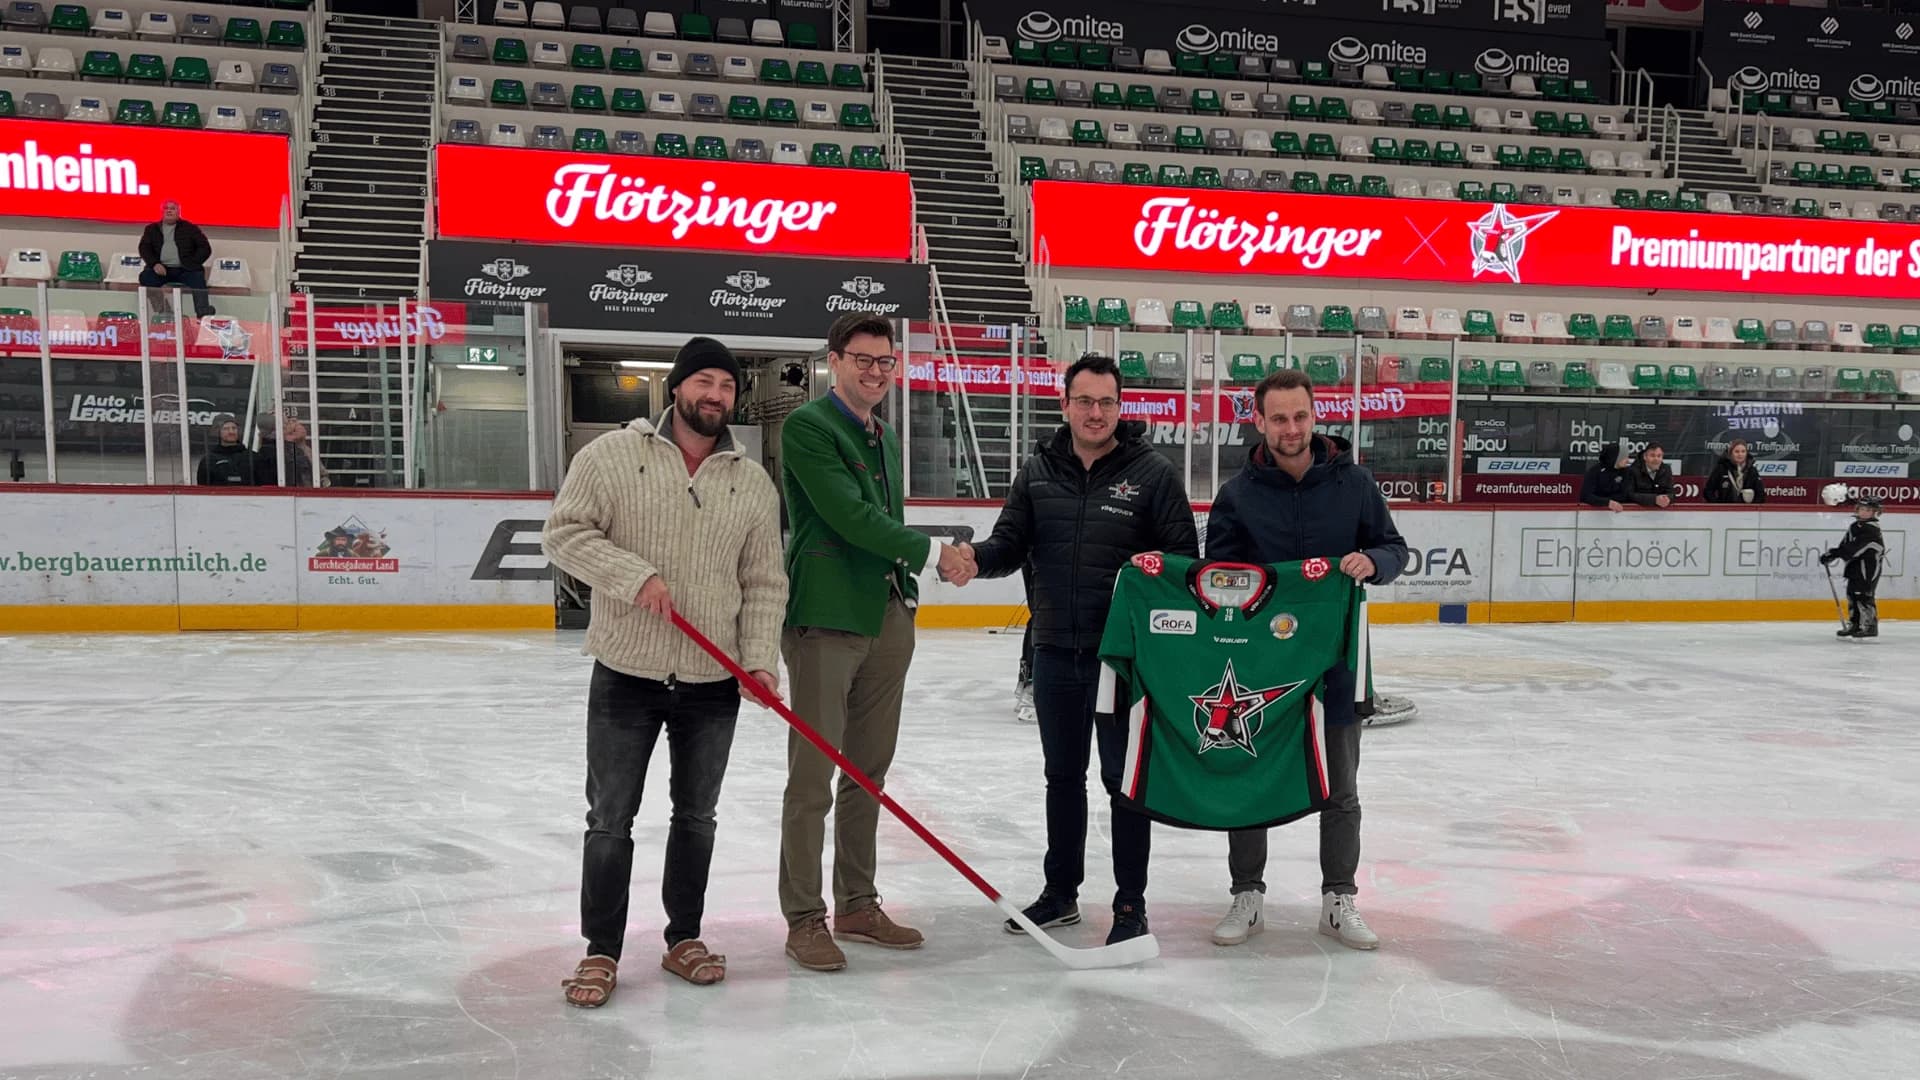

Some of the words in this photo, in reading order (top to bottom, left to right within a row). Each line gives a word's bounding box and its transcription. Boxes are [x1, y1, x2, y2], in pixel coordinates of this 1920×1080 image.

[1063, 15, 1124, 40] mitea
[1219, 28, 1279, 52] mitea
[1370, 40, 1427, 63] mitea
[1515, 51, 1570, 74] mitea
[1769, 68, 1821, 90] mitea
[1885, 77, 1920, 97] mite
[0, 138, 151, 195] nheim.
[546, 163, 837, 245] Flötzinger
[1134, 196, 1382, 270] Flötzinger
[1611, 225, 1850, 280] Premiumpartner
[1856, 236, 1904, 277] der
[1908, 240, 1920, 278] S
[464, 278, 547, 300] Flötzinger
[589, 283, 668, 306] Flötzinger
[709, 289, 786, 311] Flötzinger
[826, 294, 900, 316] Flötzinger
[84, 394, 125, 407] Auto
[1417, 434, 1507, 452] meallbau
[1890, 444, 1920, 455] Treffpu
[1487, 460, 1551, 471] BAUER
[1843, 464, 1901, 474] BAUER
[1475, 481, 1572, 495] #teamfuturehealth
[313, 559, 374, 572] Berchtesgadener
[375, 560, 394, 571] Land
[1400, 547, 1472, 576] OFA
[328, 575, 354, 585] Echt.
[358, 576, 379, 585] Gut.
[1161, 619, 1193, 630] ROFA
